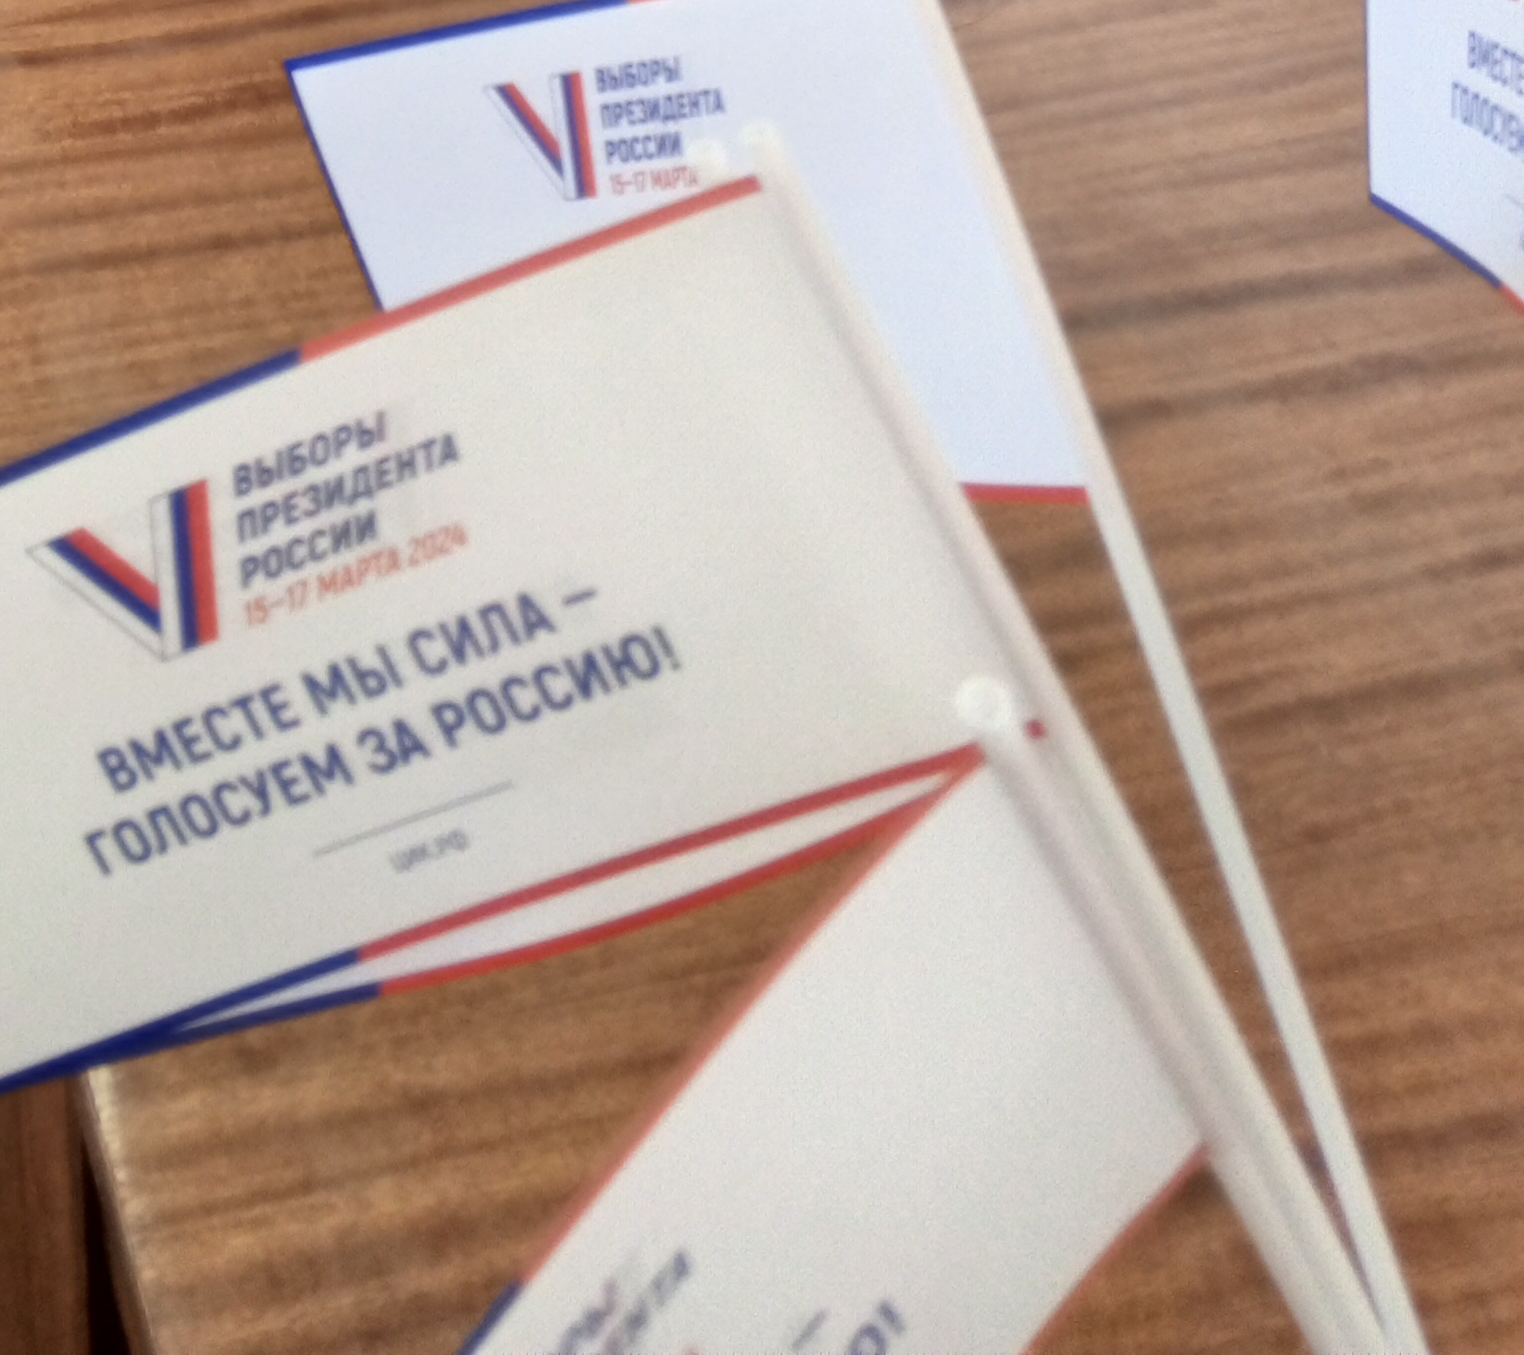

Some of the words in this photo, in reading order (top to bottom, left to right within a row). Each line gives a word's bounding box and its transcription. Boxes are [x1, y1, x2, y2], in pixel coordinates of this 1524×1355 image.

[595, 55, 682, 93] ВЫБОРЫ
[600, 87, 726, 130] ПРЕЗИДЕНТА
[604, 130, 684, 164] РОССИИ
[232, 409, 387, 499] ВЫБОРЫ
[236, 432, 460, 543] ПРЕЗИДЕНТА
[239, 507, 379, 589] РОССИИ
[317, 546, 402, 600] МАРТА
[407, 521, 469, 568] 2024
[95, 681, 302, 795] ВМЕСТЕ
[301, 643, 405, 726] МЫ
[406, 589, 557, 682] СИЛА
[83, 740, 355, 878] ГОЛОСУЕМ
[356, 717, 432, 781] ЗА
[432, 624, 683, 751] РОССИЮ!
